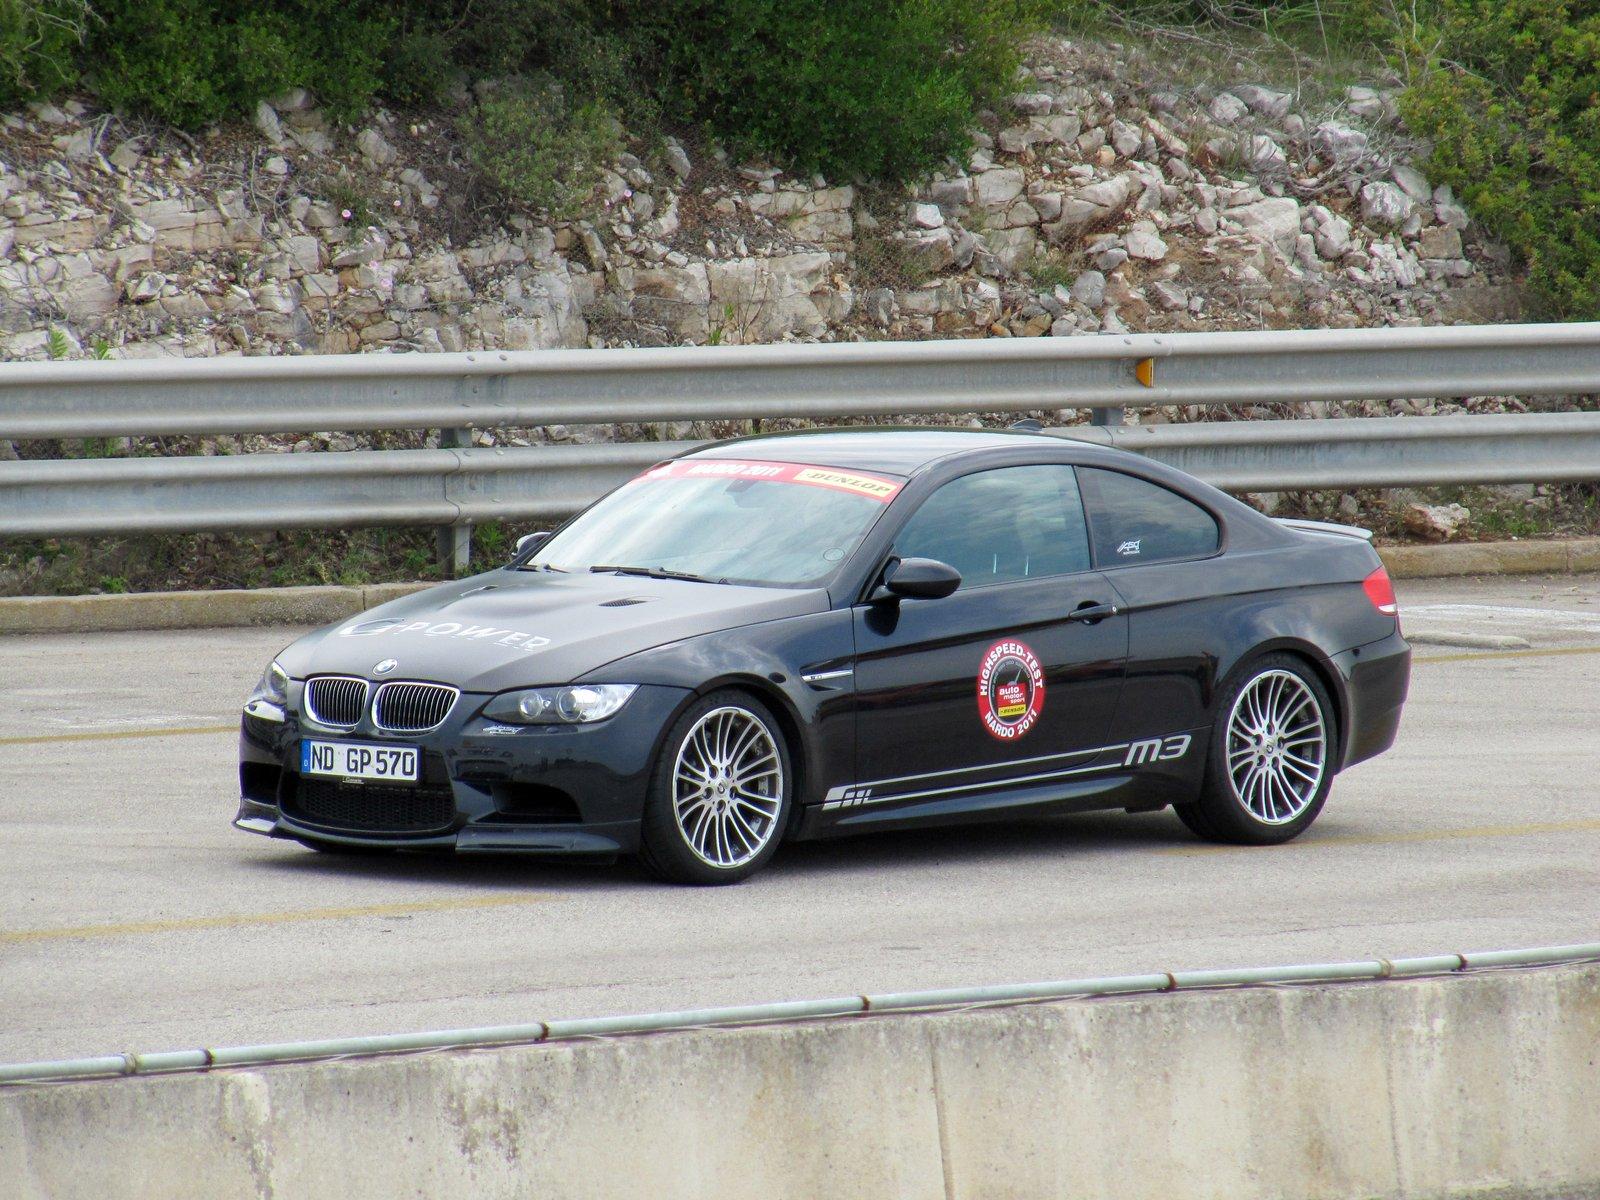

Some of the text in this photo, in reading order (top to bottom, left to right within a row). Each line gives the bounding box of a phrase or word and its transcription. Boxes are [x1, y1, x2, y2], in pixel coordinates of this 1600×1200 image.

[808, 472, 891, 493] DUNLOP
[980, 643, 1043, 696] HIGHSPEED-TEST
[1000, 686, 1019, 695] auto
[984, 708, 1038, 738] NARDO 2011
[311, 744, 415, 777] ND GP 570
